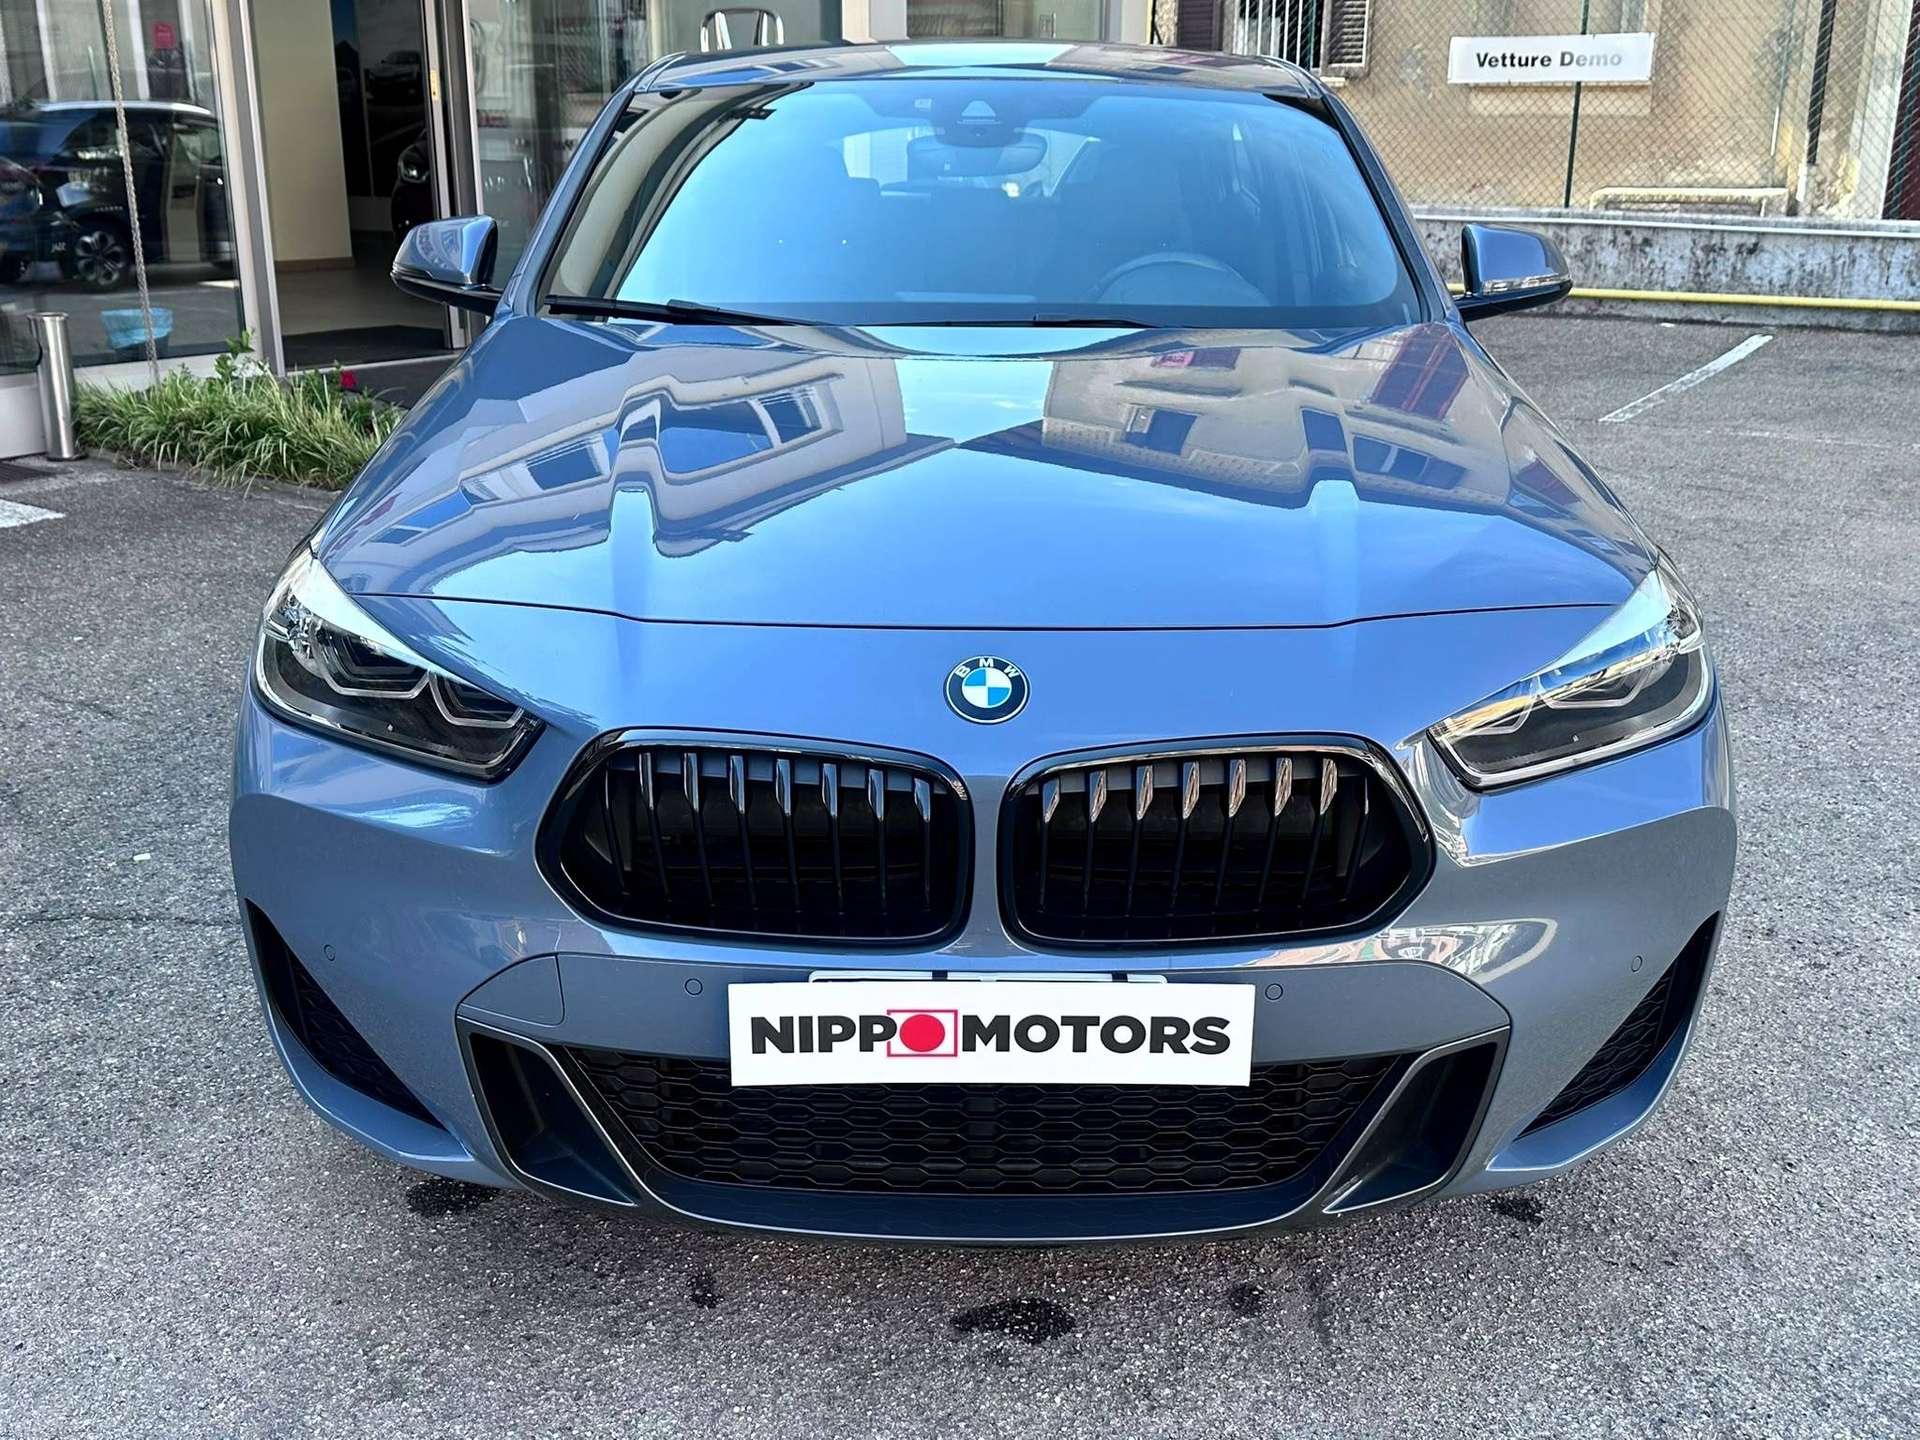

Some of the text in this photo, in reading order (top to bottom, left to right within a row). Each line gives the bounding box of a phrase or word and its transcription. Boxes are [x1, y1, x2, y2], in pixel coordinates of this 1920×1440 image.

[1476, 51, 1622, 68] Vetture Demo
[954, 658, 1020, 678] BMW
[962, 1014, 1231, 1055] MOTORS
